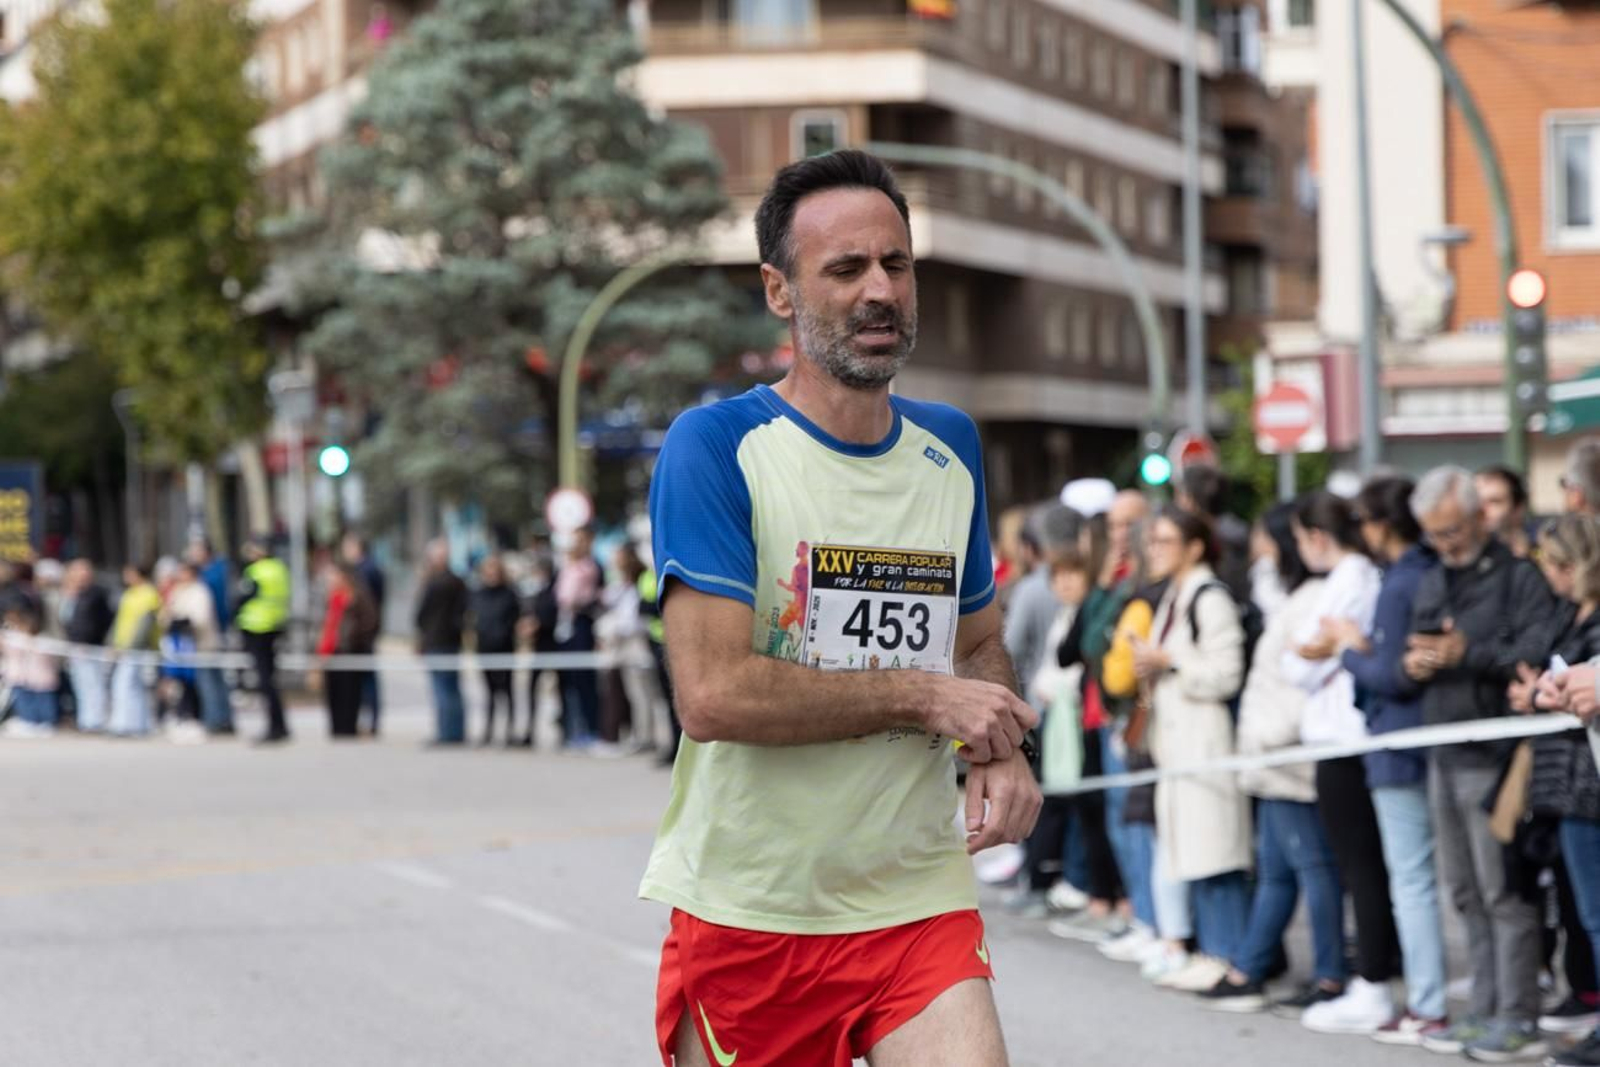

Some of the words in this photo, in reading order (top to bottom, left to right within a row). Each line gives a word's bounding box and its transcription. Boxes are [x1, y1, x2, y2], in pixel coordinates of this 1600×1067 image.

[817, 550, 855, 573] XXV
[857, 552, 908, 565] CARRERA
[909, 555, 952, 567] POPULAR
[856, 563, 865, 575] y
[872, 564, 902, 577] gran
[907, 566, 953, 579] caminata
[842, 598, 930, 652] 453
